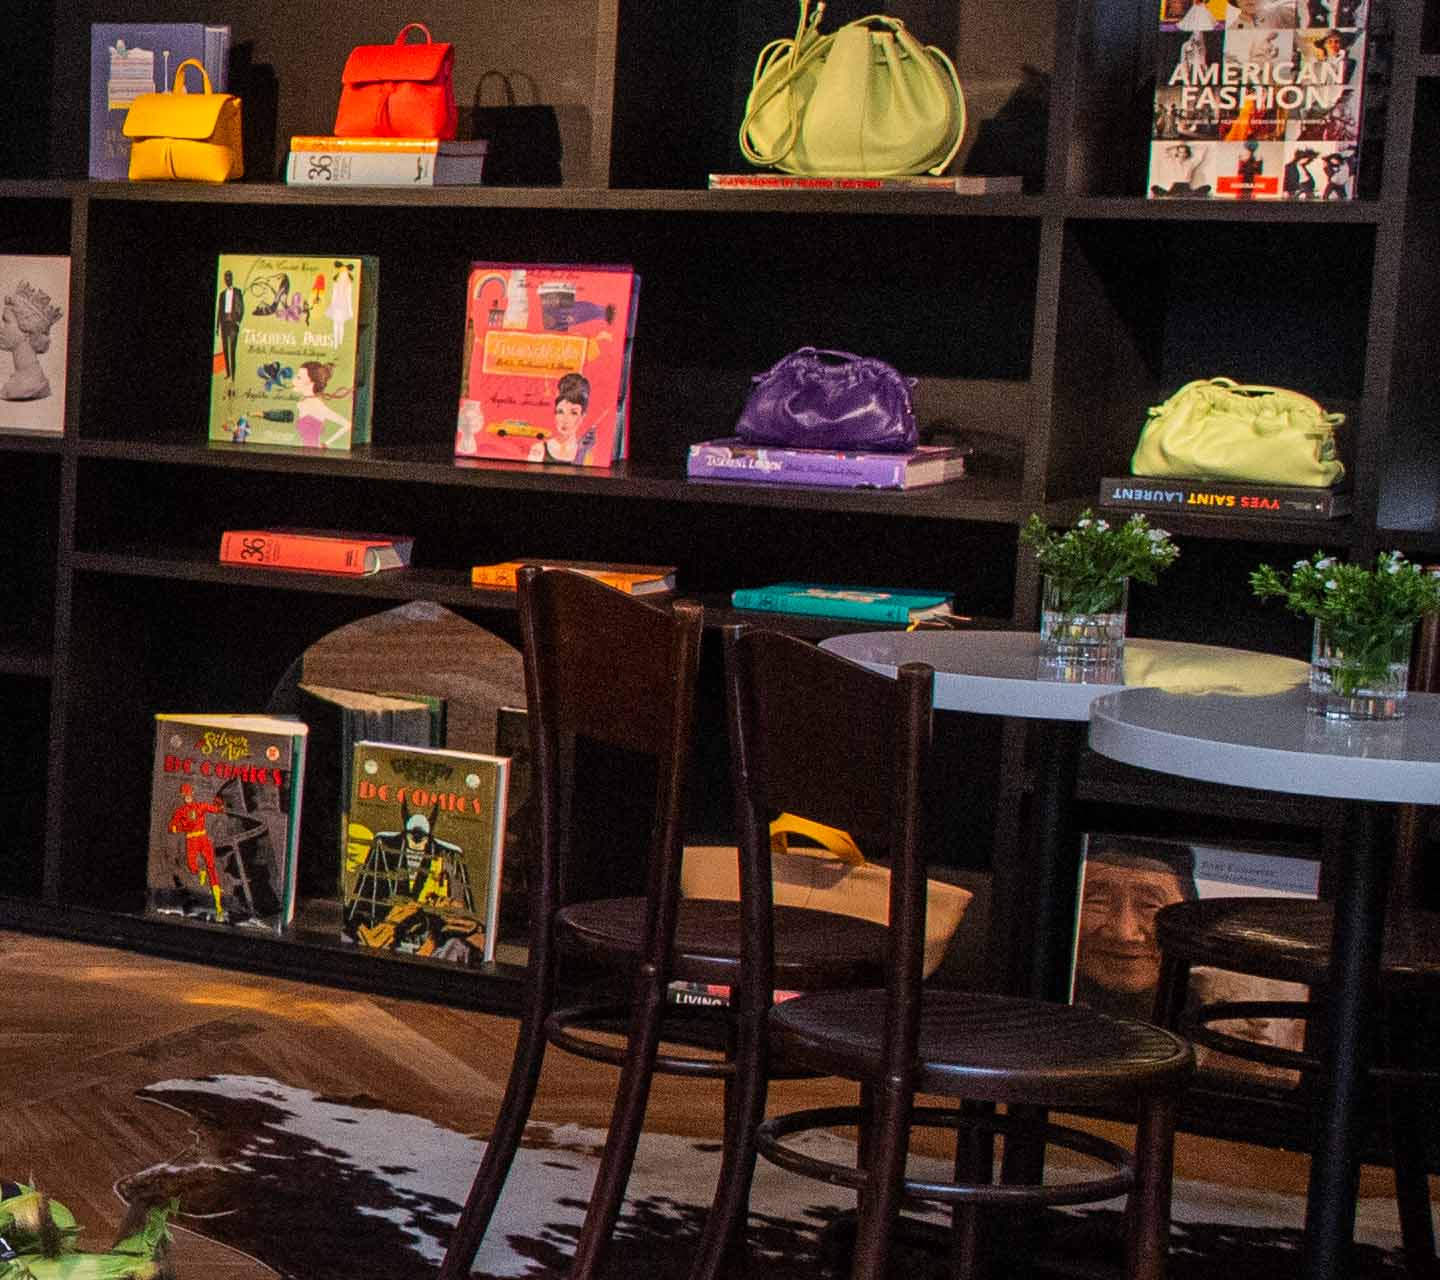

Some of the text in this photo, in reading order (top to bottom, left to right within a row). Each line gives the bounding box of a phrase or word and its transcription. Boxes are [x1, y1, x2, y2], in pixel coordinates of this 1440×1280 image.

[1167, 61, 1344, 86] AMERICAN
[1180, 85, 1332, 111] FASHION
[308, 154, 333, 181] 36
[1112, 487, 1184, 503] LAURENT
[1186, 492, 1236, 507] SAINT
[1240, 495, 1281, 510] YVES
[240, 536, 267, 562] 36
[201, 731, 249, 755] Silver
[163, 754, 283, 786] DC COMICS
[358, 778, 481, 816] DC COMICS
